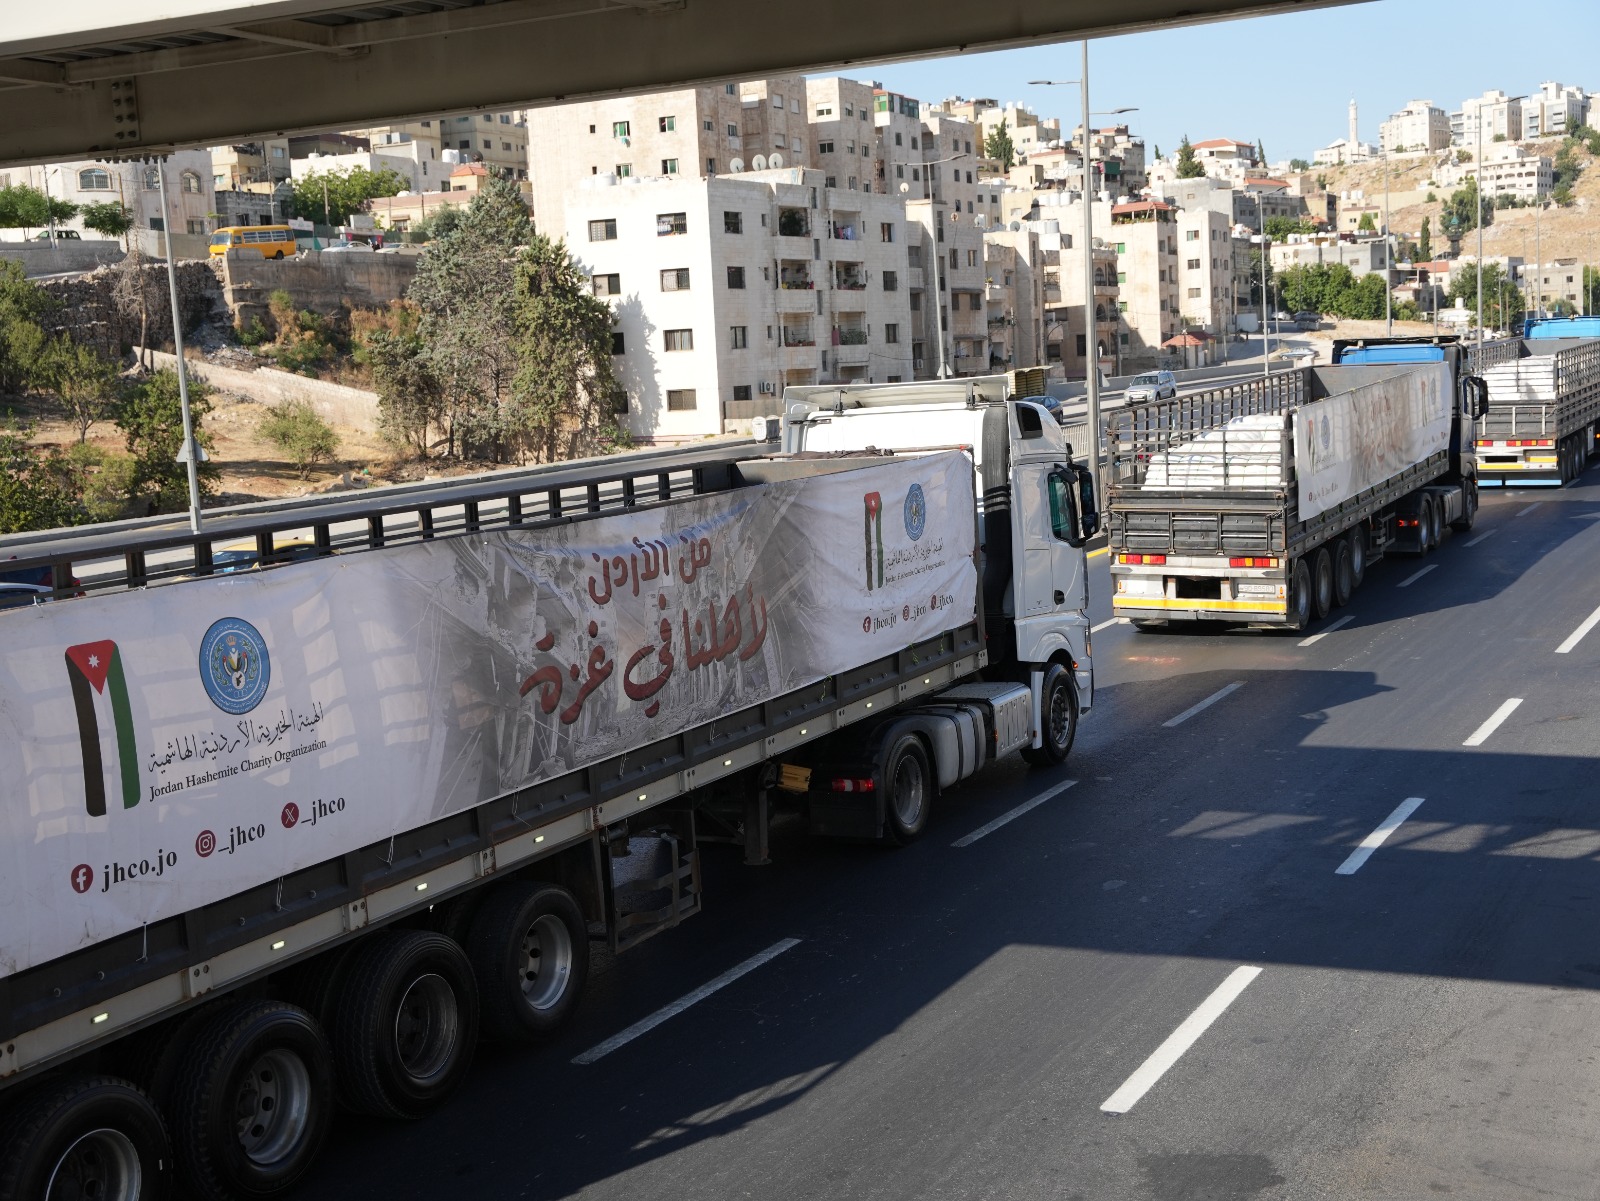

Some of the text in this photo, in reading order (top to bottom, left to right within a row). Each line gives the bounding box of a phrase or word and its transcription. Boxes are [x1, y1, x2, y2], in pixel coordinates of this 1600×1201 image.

[588, 535, 711, 605] من الأردن
[519, 581, 768, 725] لأهلنا في غزة
[148, 701, 324, 774] الهيئة الخيرية الأردنية الهاشمية
[150, 739, 327, 802] Jordan Hashemite Charity Organization
[101, 797, 346, 893] jhco.jo _jhco _jhco
